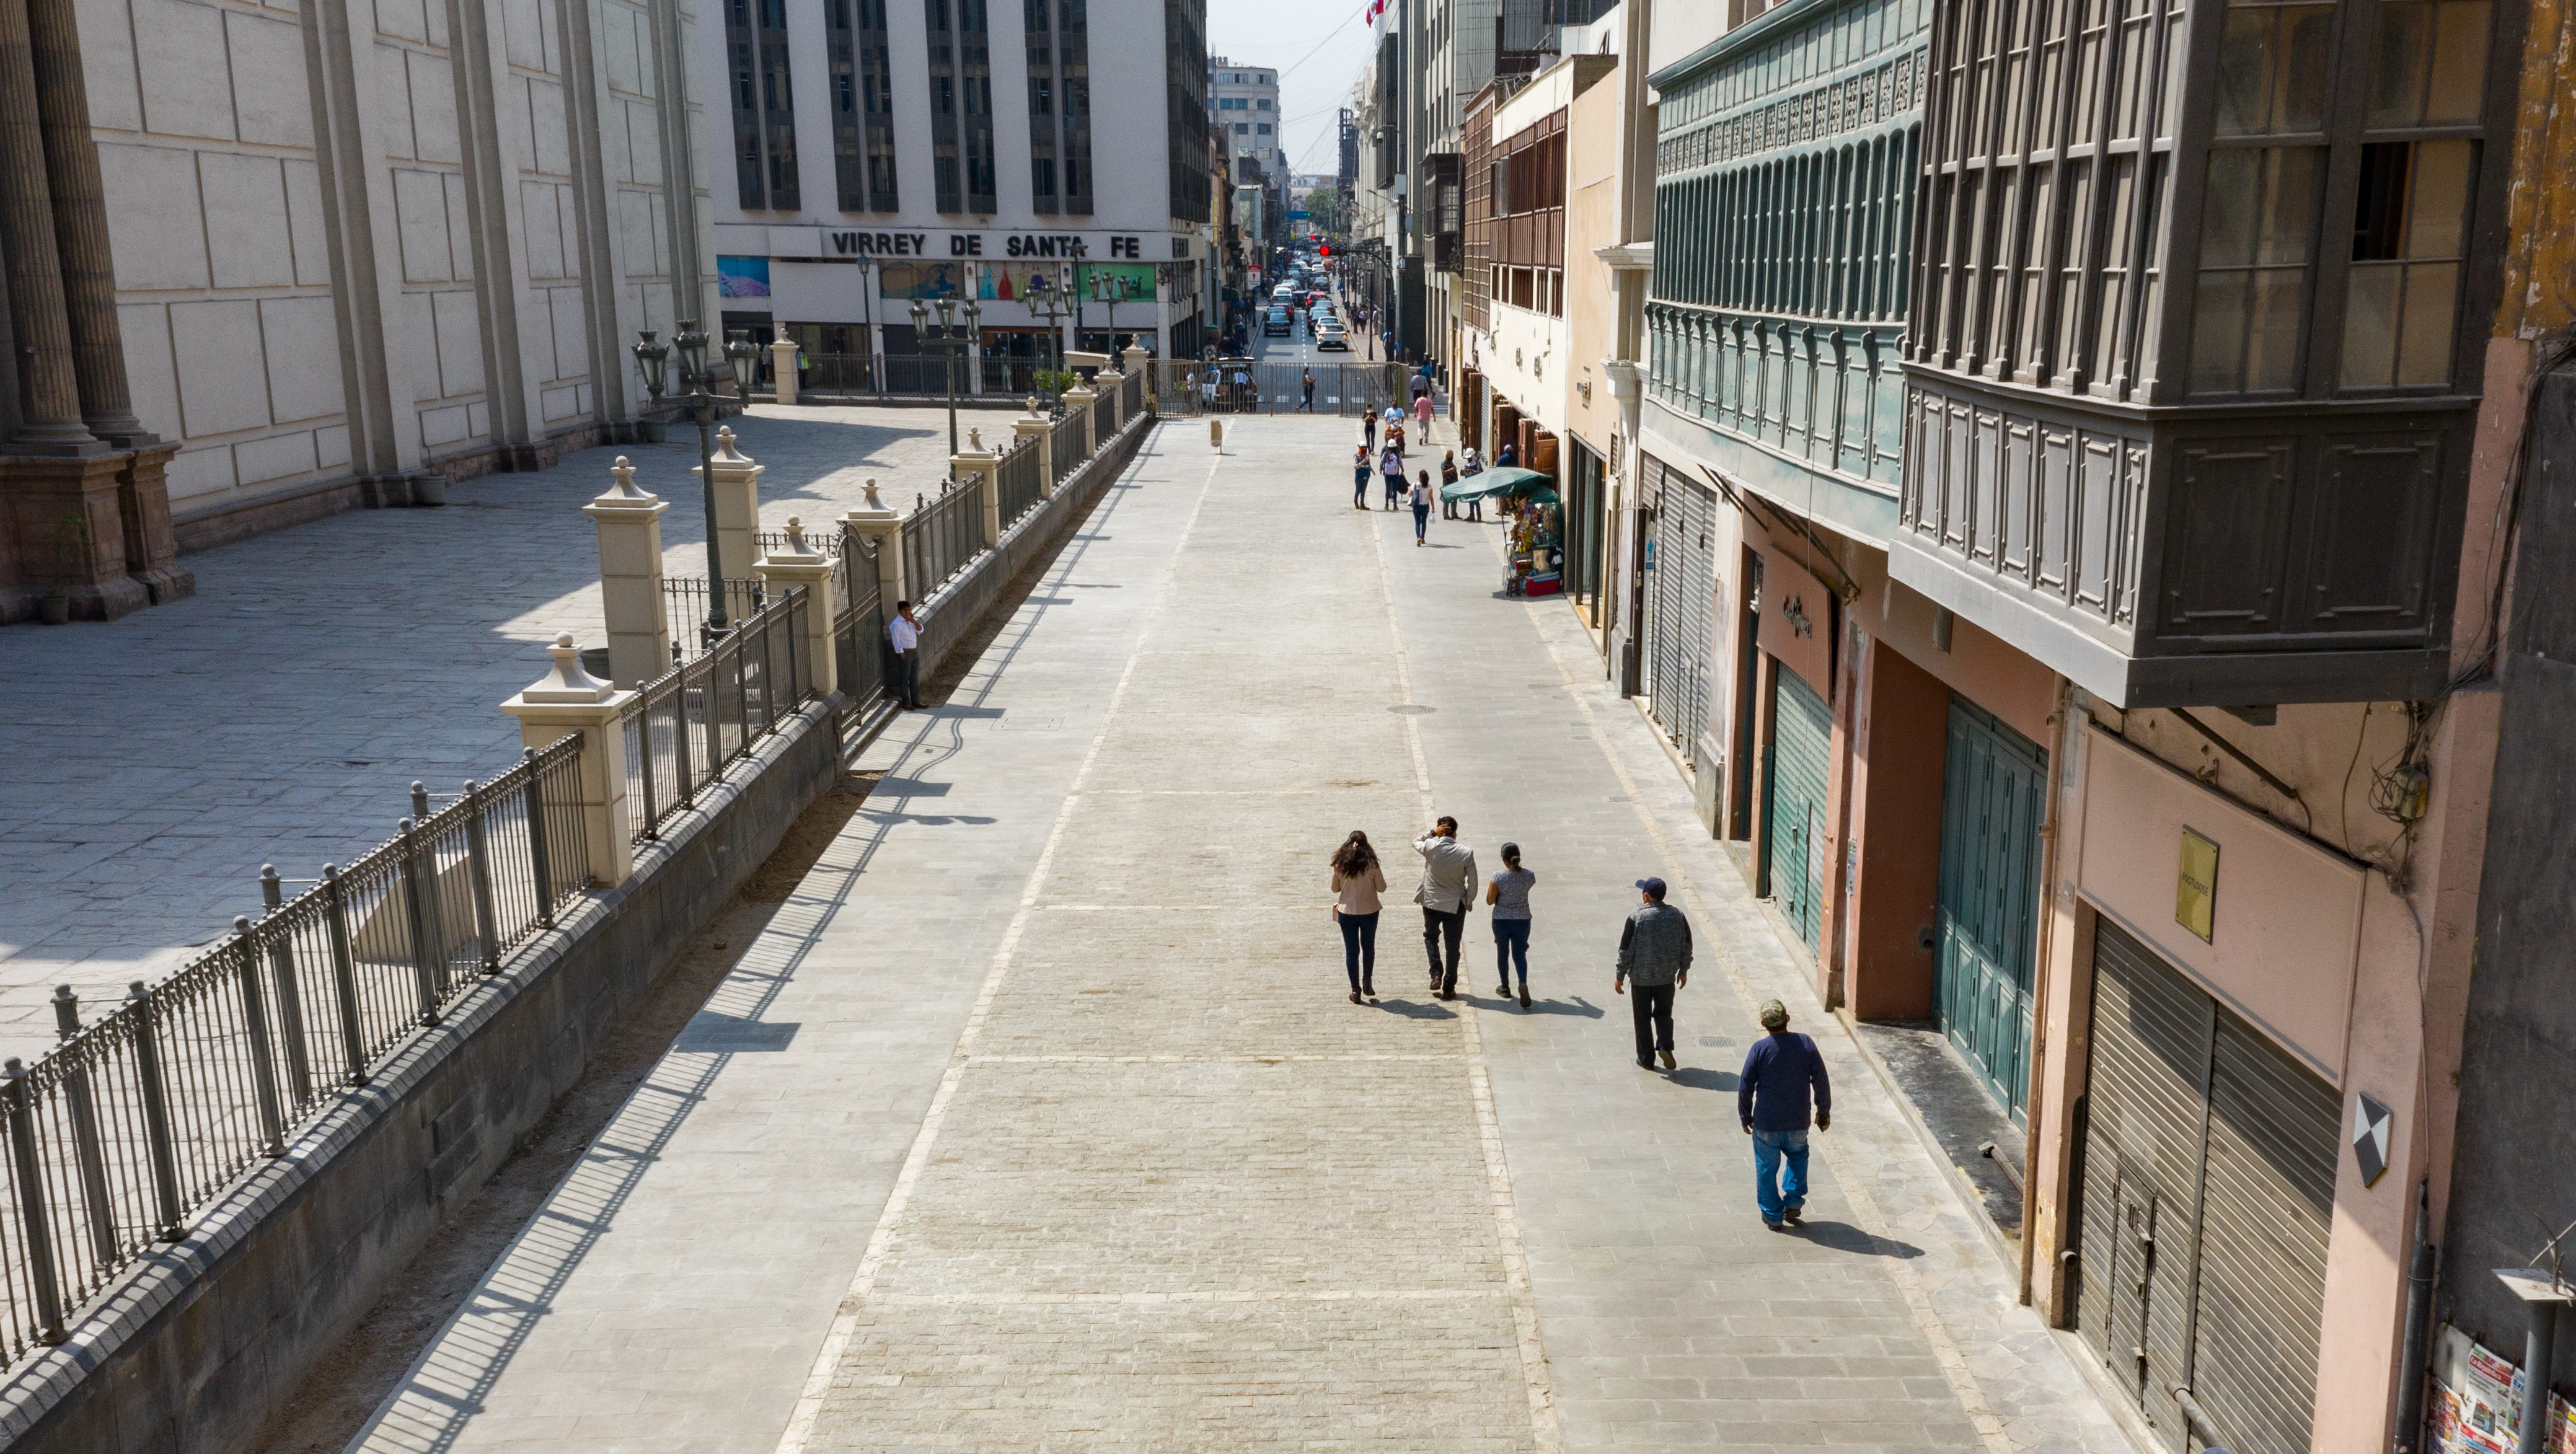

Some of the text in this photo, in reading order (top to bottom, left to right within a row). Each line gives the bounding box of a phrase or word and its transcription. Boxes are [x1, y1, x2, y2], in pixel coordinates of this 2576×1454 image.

[832, 232, 1139, 258] VIRREY DE SANTA FE
[2182, 872, 2209, 897] FOOTLOOSE
